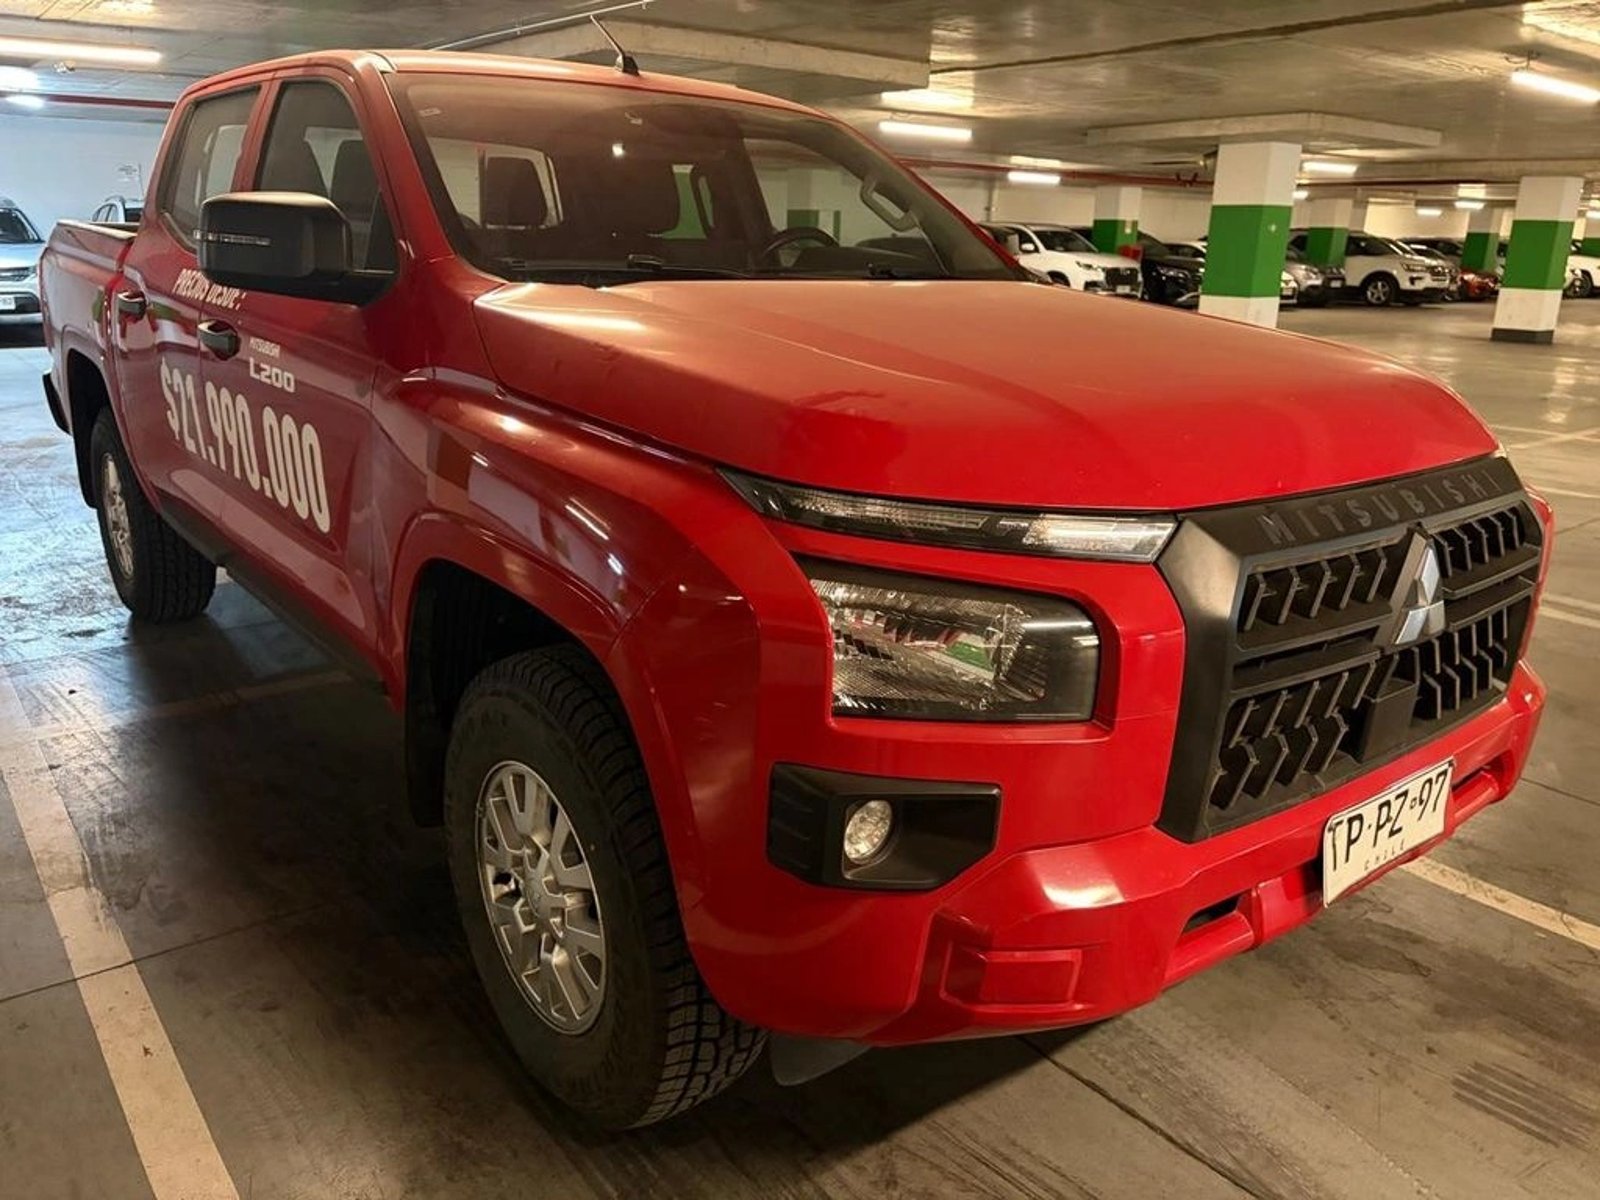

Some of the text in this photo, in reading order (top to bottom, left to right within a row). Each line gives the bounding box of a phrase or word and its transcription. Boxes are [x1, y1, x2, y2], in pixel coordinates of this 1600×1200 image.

[250, 357, 295, 393] L200
[160, 356, 331, 533] $21.990.000
[1256, 470, 1500, 546] MITSUBISHI
